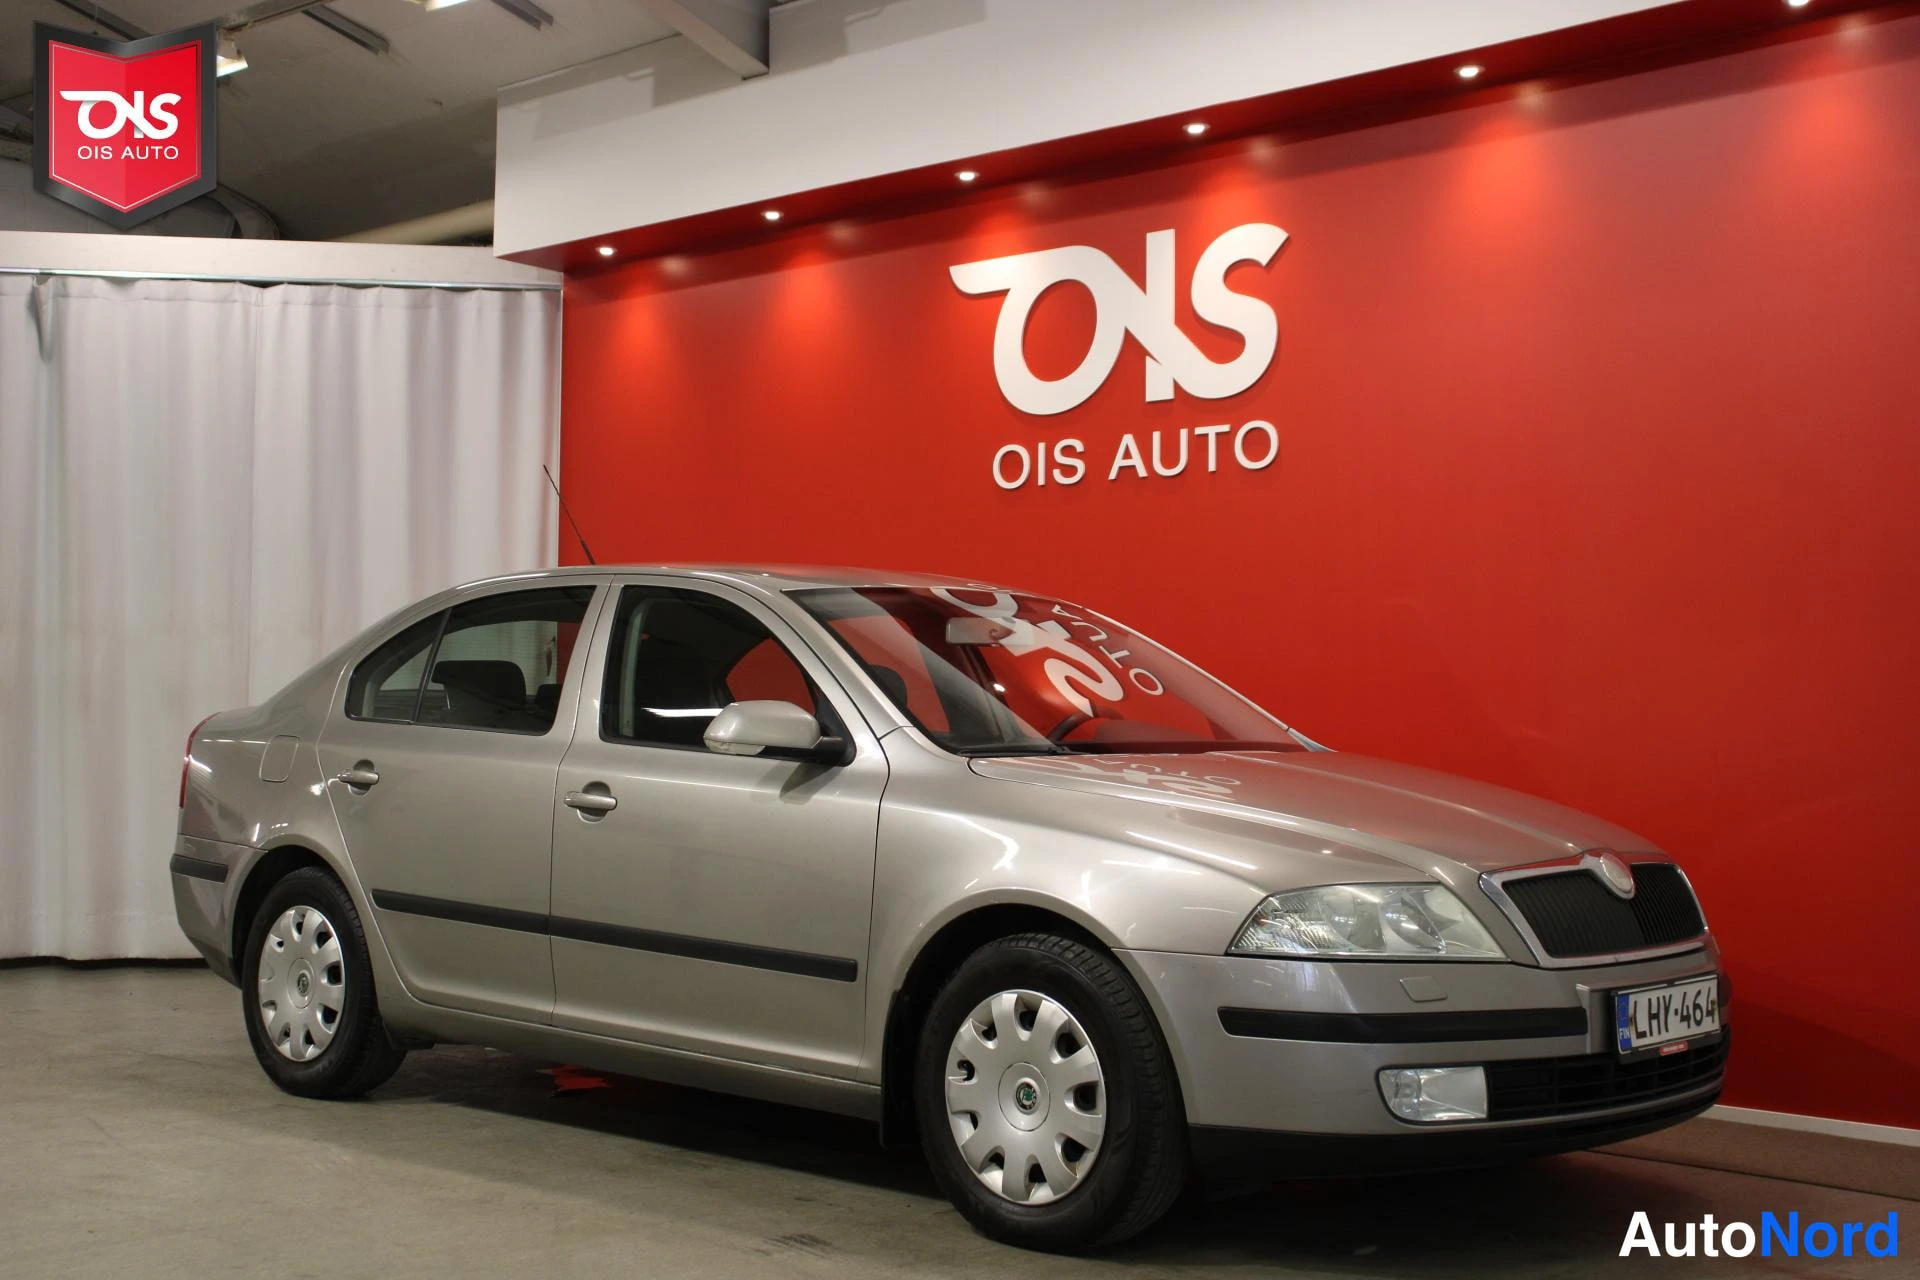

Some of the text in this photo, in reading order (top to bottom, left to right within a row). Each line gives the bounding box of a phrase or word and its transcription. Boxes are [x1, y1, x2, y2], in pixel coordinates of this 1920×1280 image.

[949, 222, 1289, 415] OIS
[992, 419, 1279, 490] OIS AUTO
[1633, 986, 1716, 1040] LHY-464
